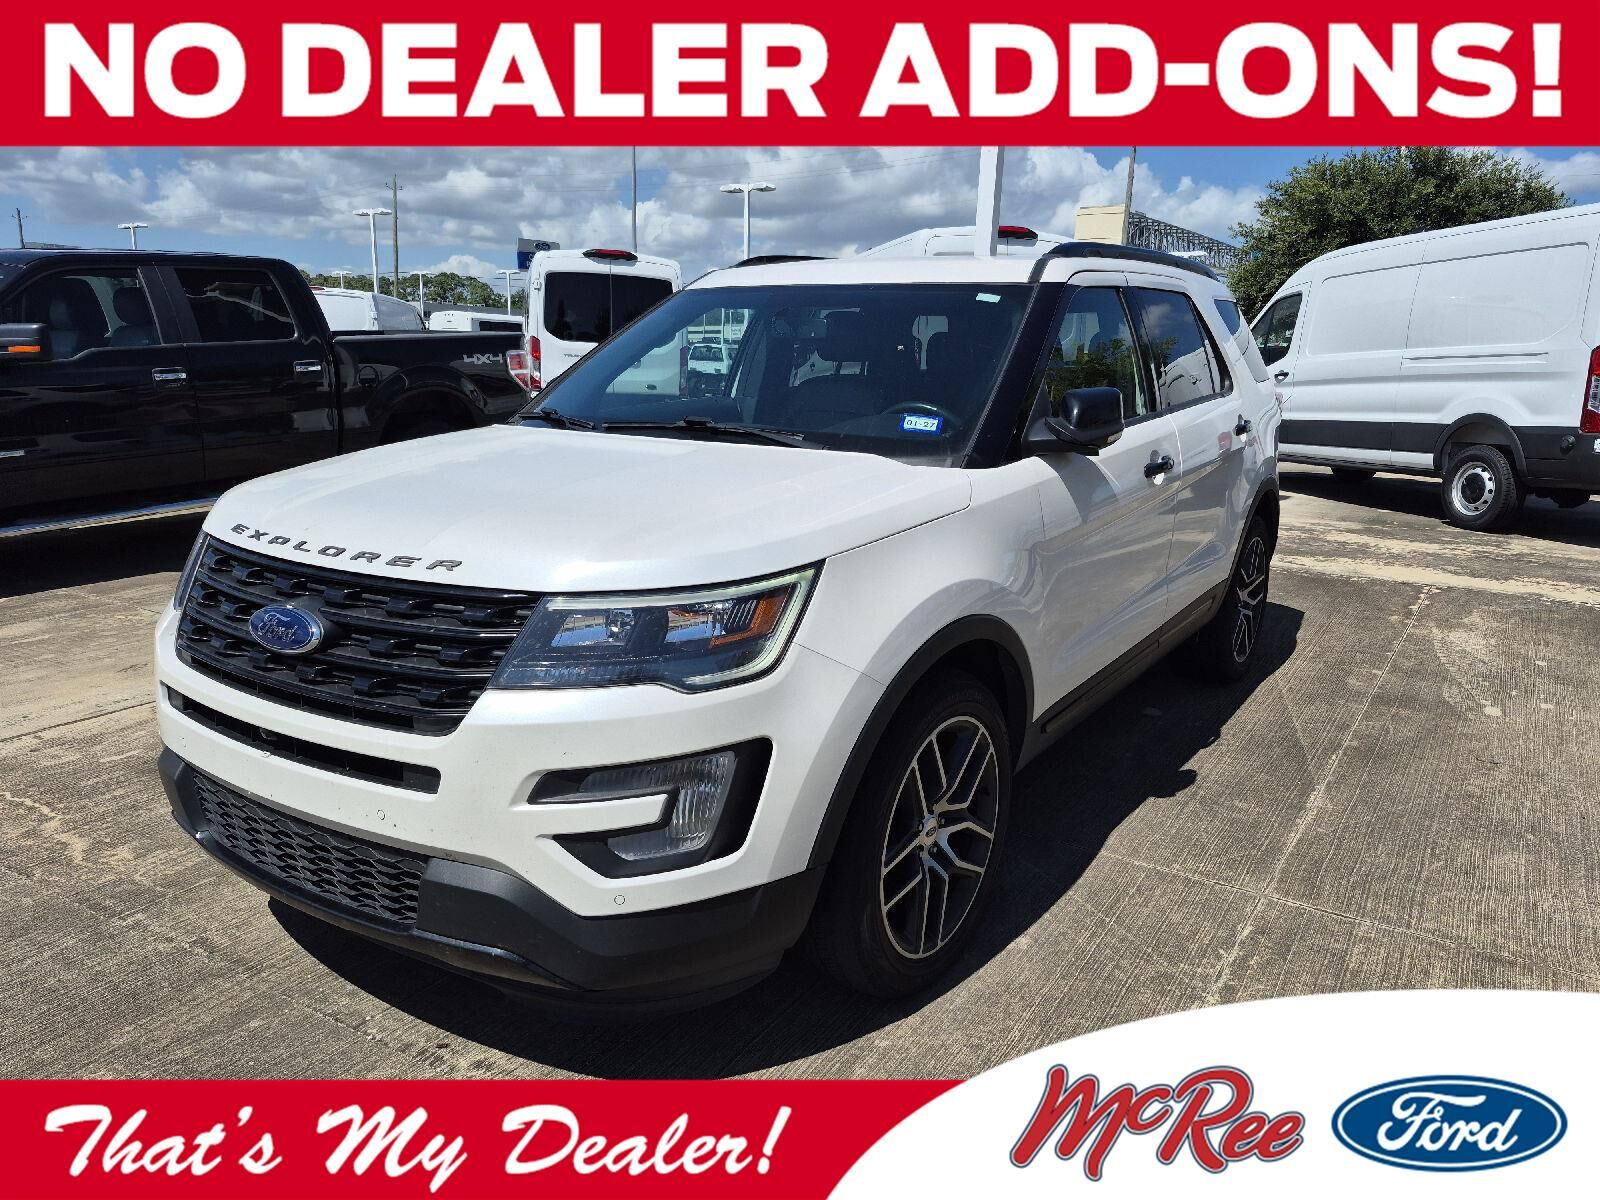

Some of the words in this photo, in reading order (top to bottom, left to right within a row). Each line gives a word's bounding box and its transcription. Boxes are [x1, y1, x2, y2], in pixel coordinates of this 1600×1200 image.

[907, 419, 936, 429] 01-27
[231, 523, 463, 572] EXPLORER
[257, 611, 299, 643] Ford
